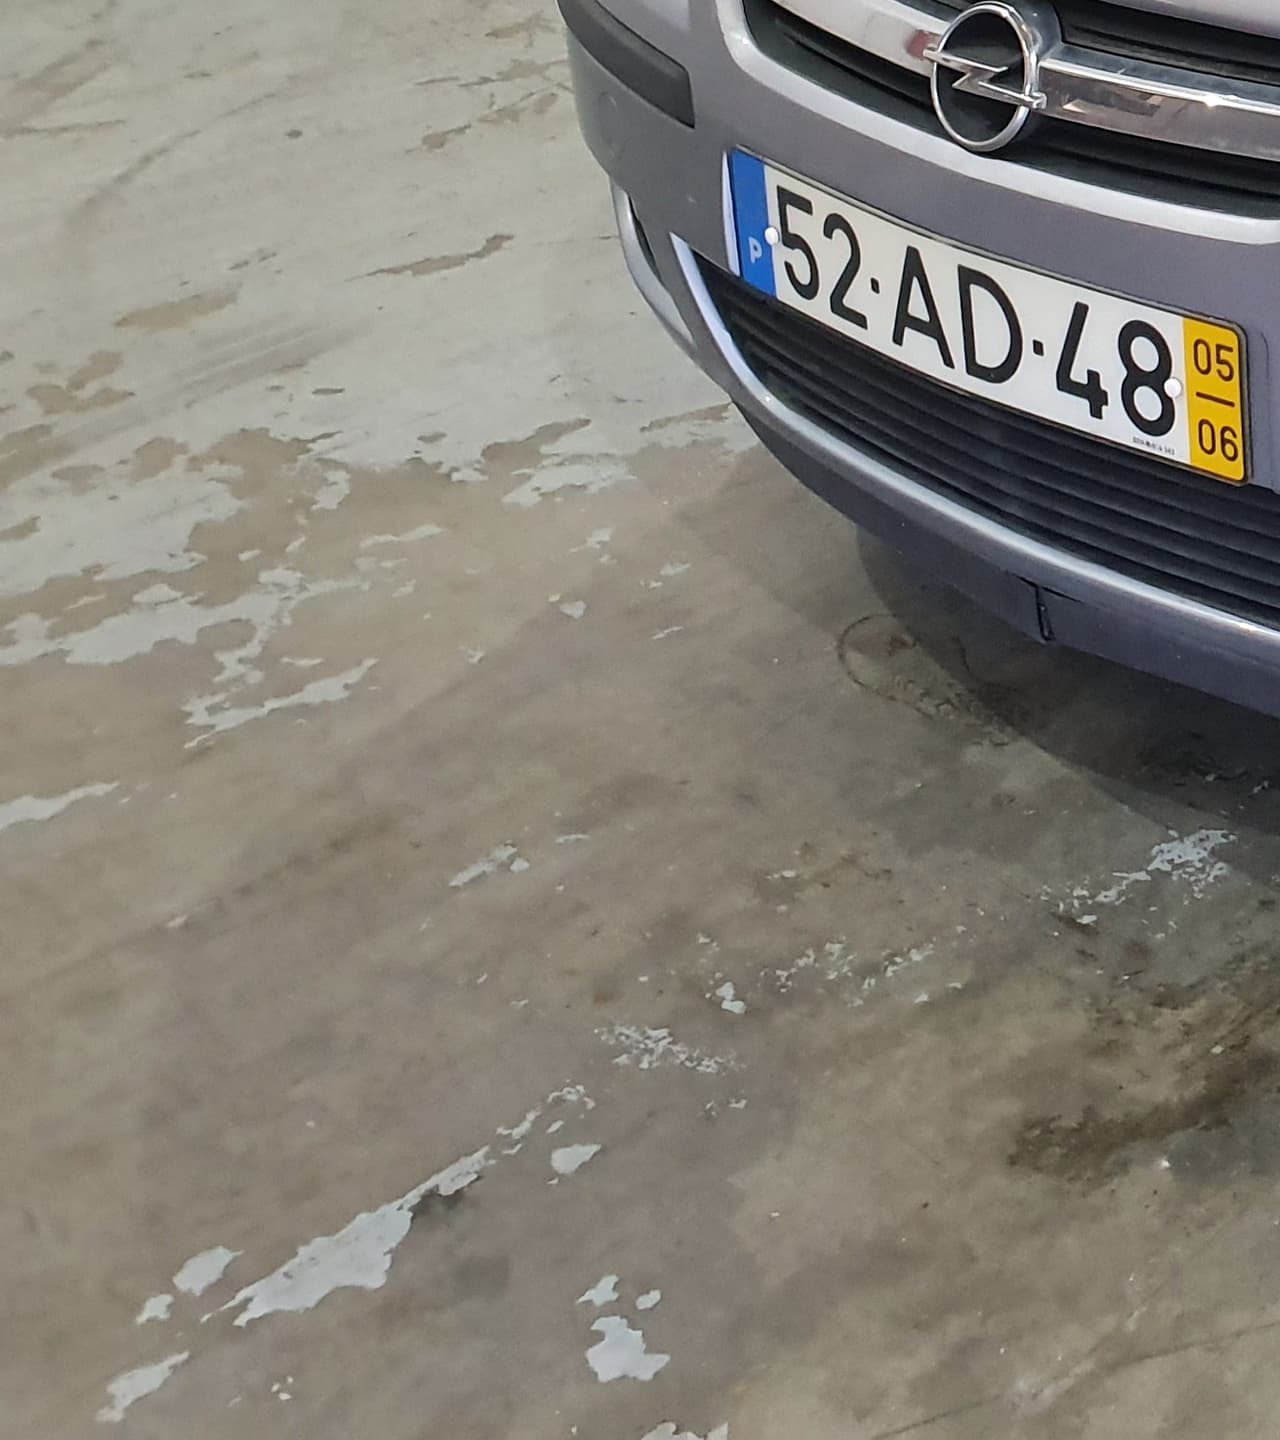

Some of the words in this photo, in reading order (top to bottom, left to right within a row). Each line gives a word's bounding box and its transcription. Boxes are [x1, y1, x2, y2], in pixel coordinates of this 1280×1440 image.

[748, 236, 763, 264] P
[1193, 338, 1235, 382] 05
[1198, 418, 1239, 462] 06
